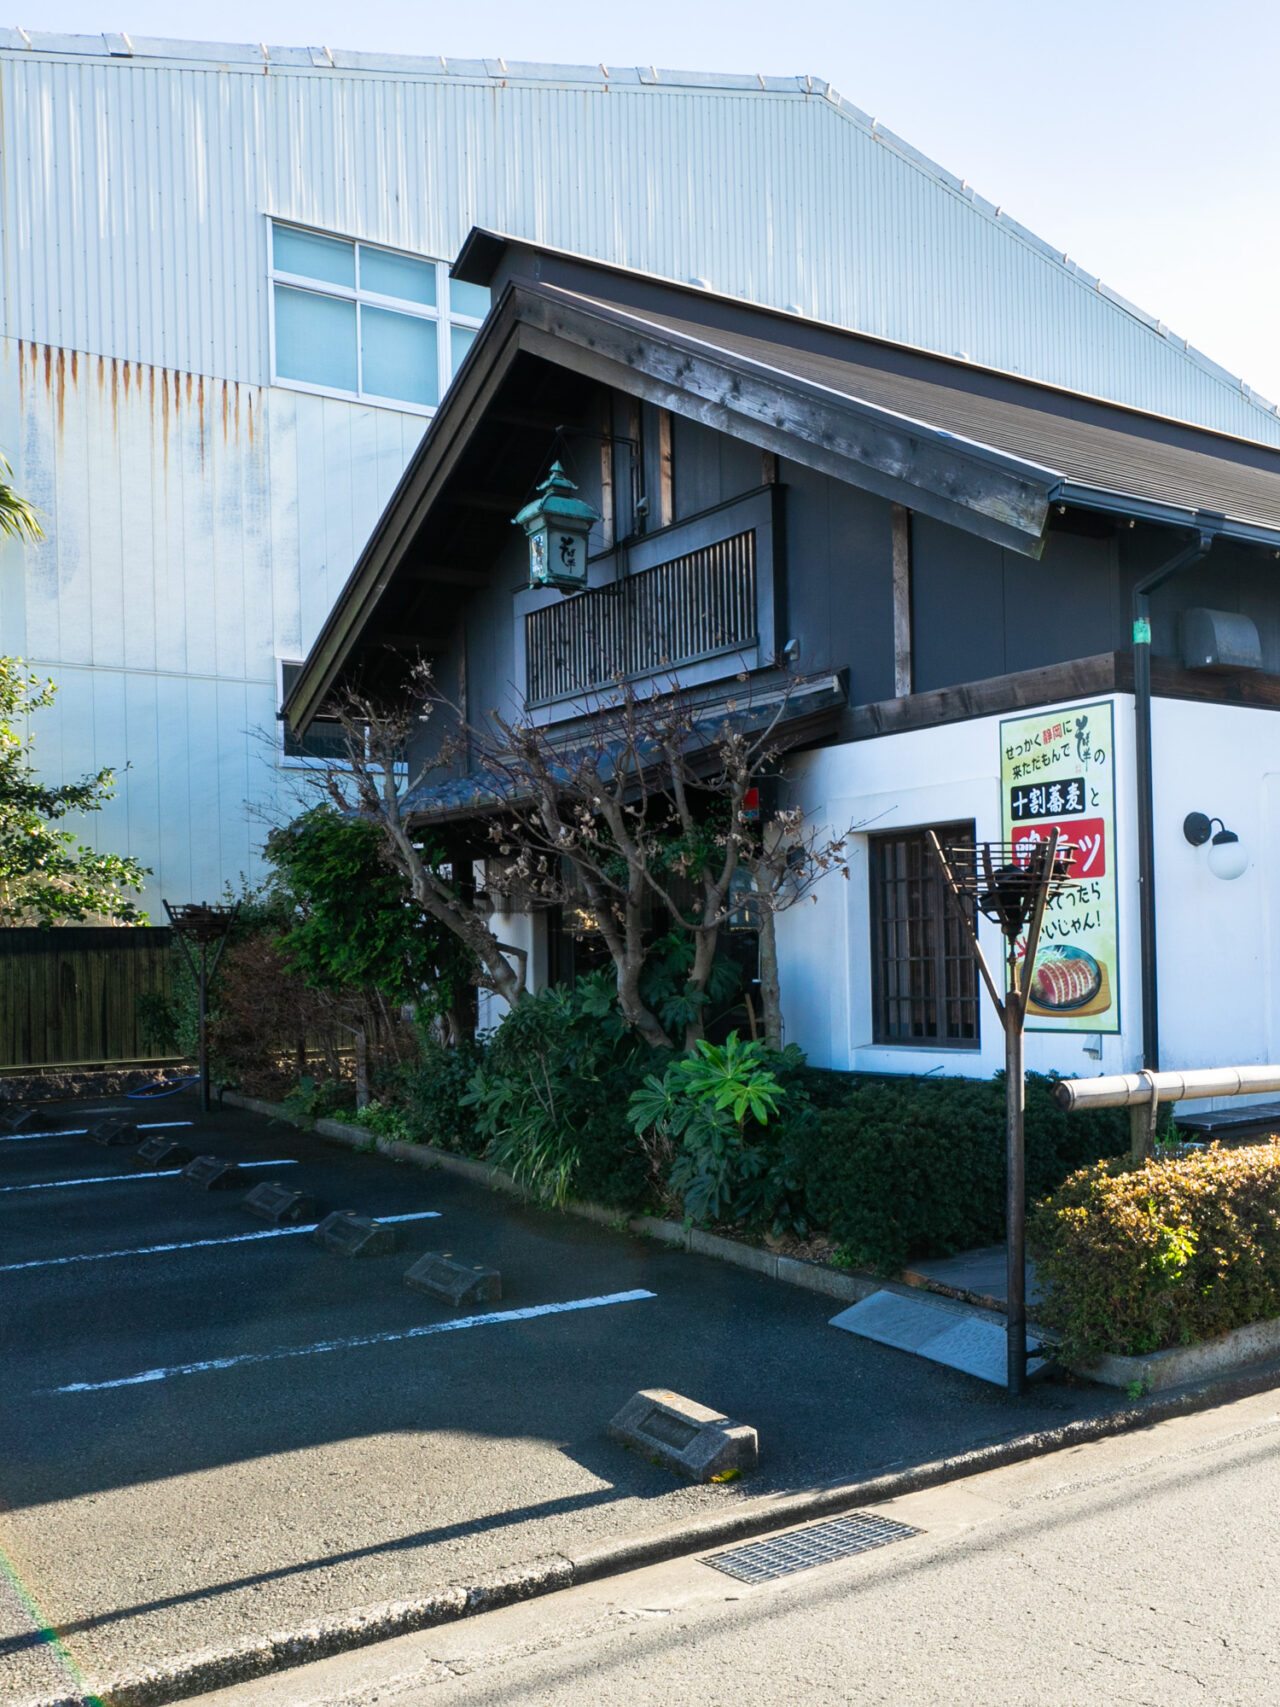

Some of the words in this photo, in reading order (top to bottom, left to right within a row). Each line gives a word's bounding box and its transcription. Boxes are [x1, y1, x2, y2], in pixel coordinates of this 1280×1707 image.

[1006, 720, 1073, 760] せっかく静岡に
[1012, 743, 1070, 780] 来ただもんで
[1013, 782, 1083, 816] 十割蕎麦
